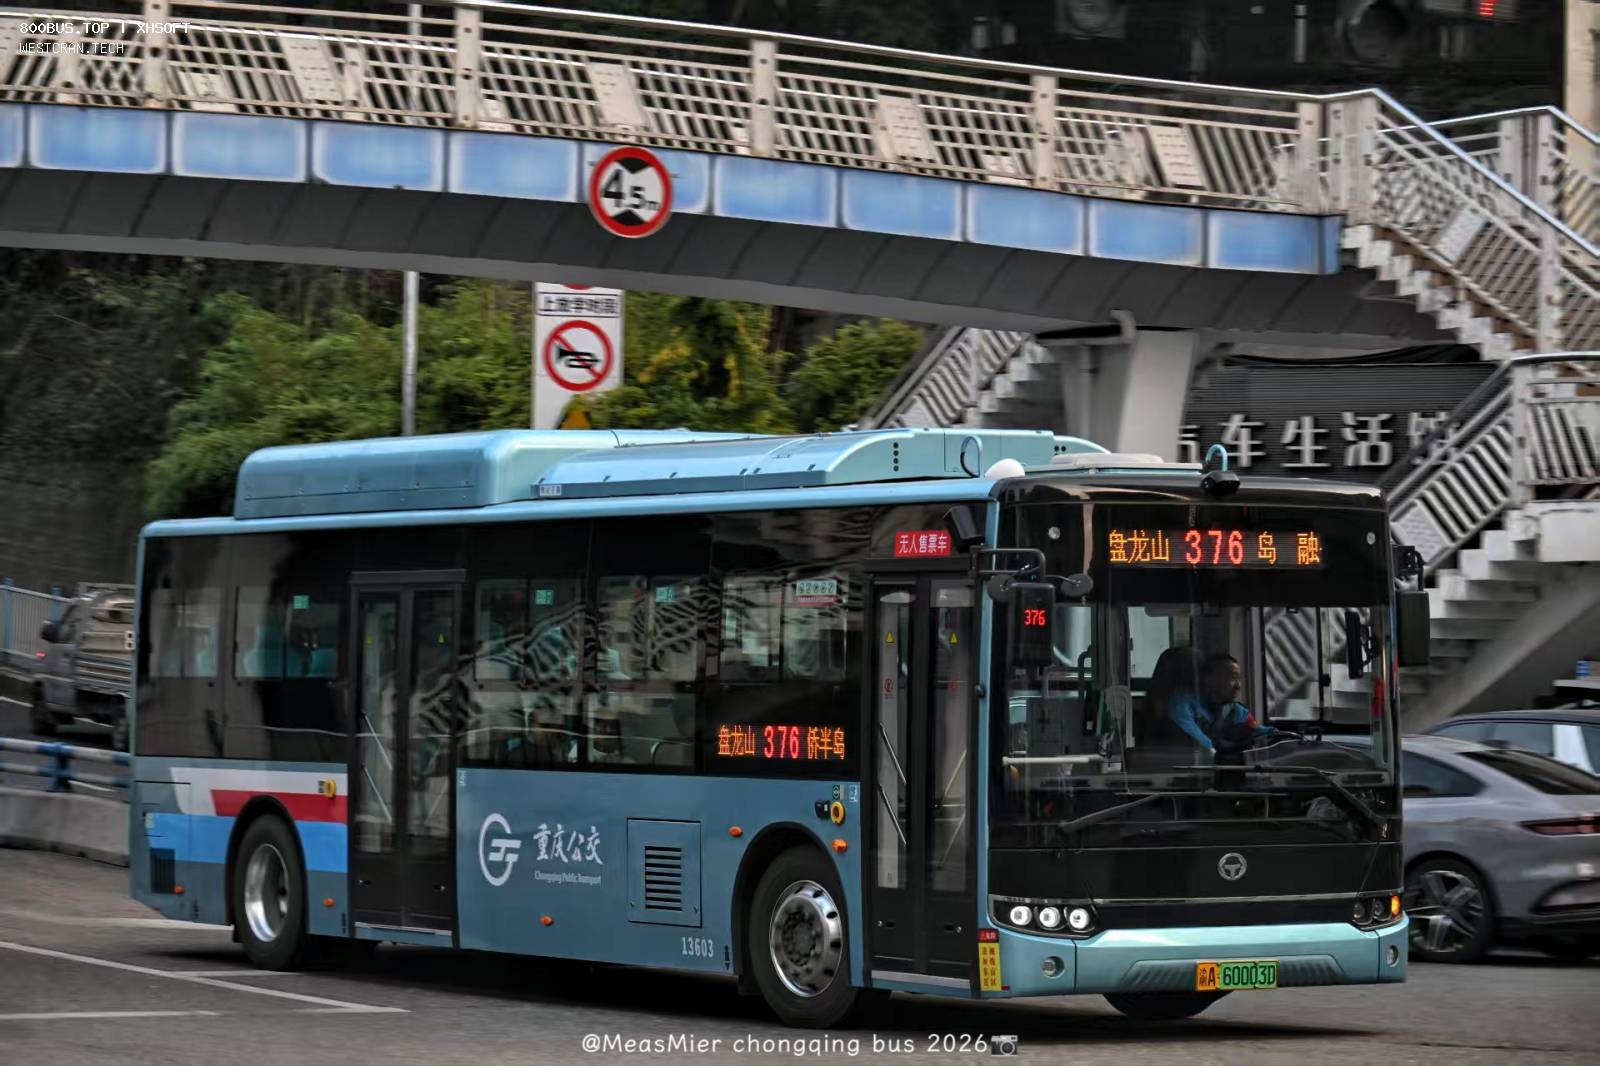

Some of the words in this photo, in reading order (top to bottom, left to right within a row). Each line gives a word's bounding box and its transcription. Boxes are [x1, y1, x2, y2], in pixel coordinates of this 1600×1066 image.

[898, 534, 948, 553] 无人售票车
[1109, 529, 1170, 563] 盘龙山
[1184, 530, 1245, 565] 376
[1257, 531, 1277, 565] 岛
[1296, 531, 1322, 565] 融
[1024, 609, 1046, 626] 376
[717, 725, 756, 757] 盘龙山
[764, 725, 800, 759] 376
[533, 823, 603, 865] 重庆公交
[681, 936, 715, 959] 13603
